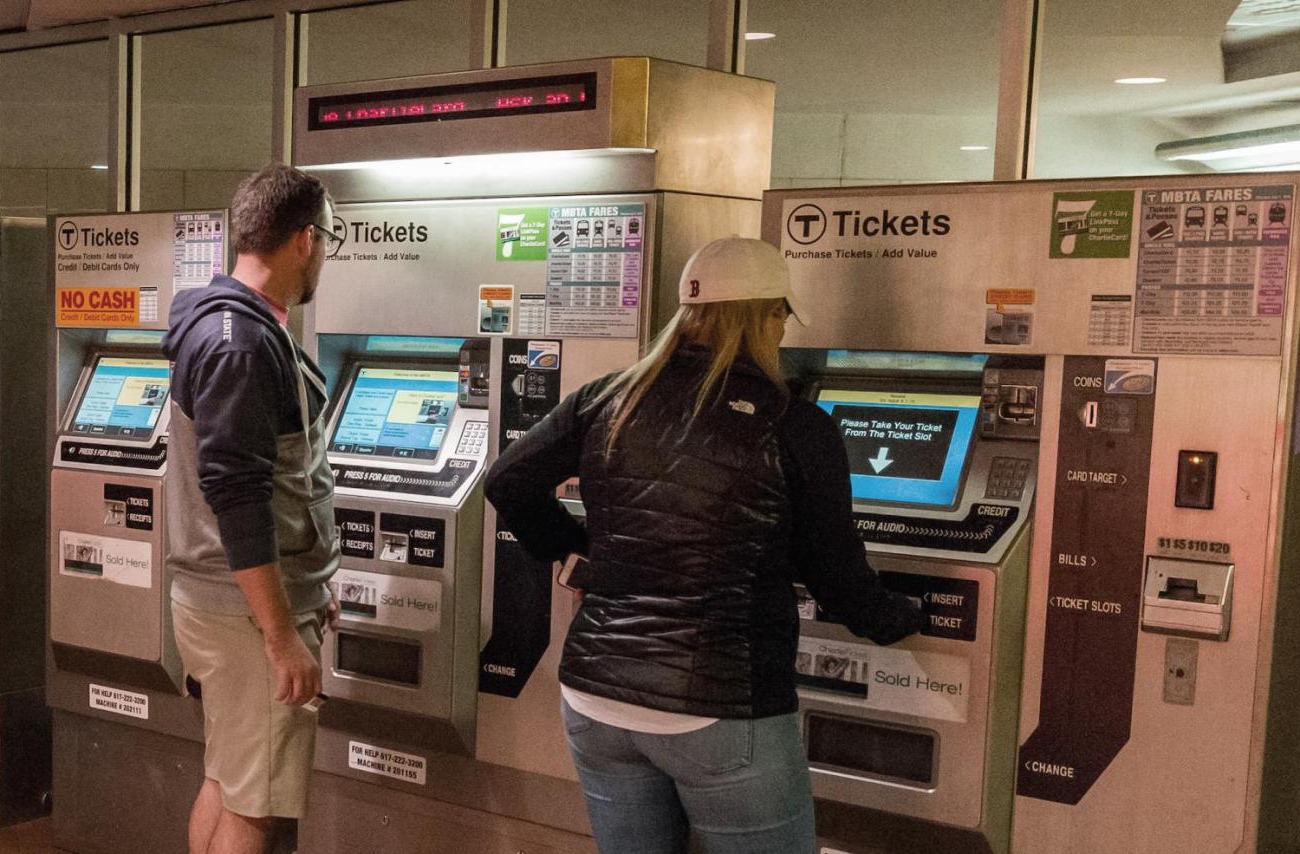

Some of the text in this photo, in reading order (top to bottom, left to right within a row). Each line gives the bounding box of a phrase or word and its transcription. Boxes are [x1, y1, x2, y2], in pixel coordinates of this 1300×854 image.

[1161, 190, 1201, 203] MBTA
[1206, 189, 1253, 202] FARES
[561, 206, 619, 217] MBTA FARES
[832, 210, 951, 237] Tickets
[81, 228, 140, 247] Tickets
[351, 222, 428, 243] Tickets
[353, 253, 420, 261] Tickets Add Value
[785, 250, 832, 259] Purchase
[836, 250, 873, 259] Tickets
[882, 249, 904, 258] Add
[907, 249, 938, 258] Value
[58, 263, 78, 272] Credit
[83, 263, 100, 271] Debit
[102, 263, 122, 271] Cards
[124, 263, 140, 272] Only
[689, 280, 700, 298] B
[61, 291, 85, 309] NO
[89, 291, 135, 309] CASH
[61, 313, 79, 321] Credit
[84, 313, 100, 321] Debit
[121, 314, 134, 323] Only
[223, 319, 232, 343] STATE
[509, 355, 528, 365] COINS
[1074, 376, 1102, 388] COINS
[841, 418, 943, 432] Please Take Your Ticket
[506, 429, 520, 440] CARD
[845, 428, 932, 441] From The Ticket Slot
[449, 460, 471, 469] CREDIT
[344, 470, 364, 480] PRESS
[369, 472, 382, 481] FOR
[382, 474, 401, 483] AUDIO
[1067, 470, 1118, 484] CARD TARGET
[130, 497, 149, 507] TICKETS
[130, 513, 152, 524] RECEIPTS
[978, 506, 1011, 518] CREDIT
[347, 522, 370, 533] TICKETS
[857, 520, 906, 534] FOR AUDIO
[414, 530, 436, 540] INSERT
[346, 539, 373, 551] RECEIPTS
[1158, 537, 1230, 555] $1 $5 $10 $20
[414, 547, 436, 559] TICKET
[106, 554, 149, 569] Sold Here!
[1058, 553, 1087, 567] BILLS
[381, 594, 438, 613] Sold Here!
[931, 593, 965, 607] INSERT
[1056, 596, 1122, 615] TICKET SLOTS
[930, 615, 963, 629] TICKET
[488, 664, 516, 677] CHANGE
[875, 670, 963, 696] Sold Here!
[92, 688, 101, 696] FOR
[101, 690, 112, 698] HELP
[96, 699, 118, 710] MACHINE
[352, 745, 363, 755] FOR
[365, 748, 380, 758] HELP
[357, 758, 386, 772] MACHINE
[1032, 761, 1075, 778] CHANGE
